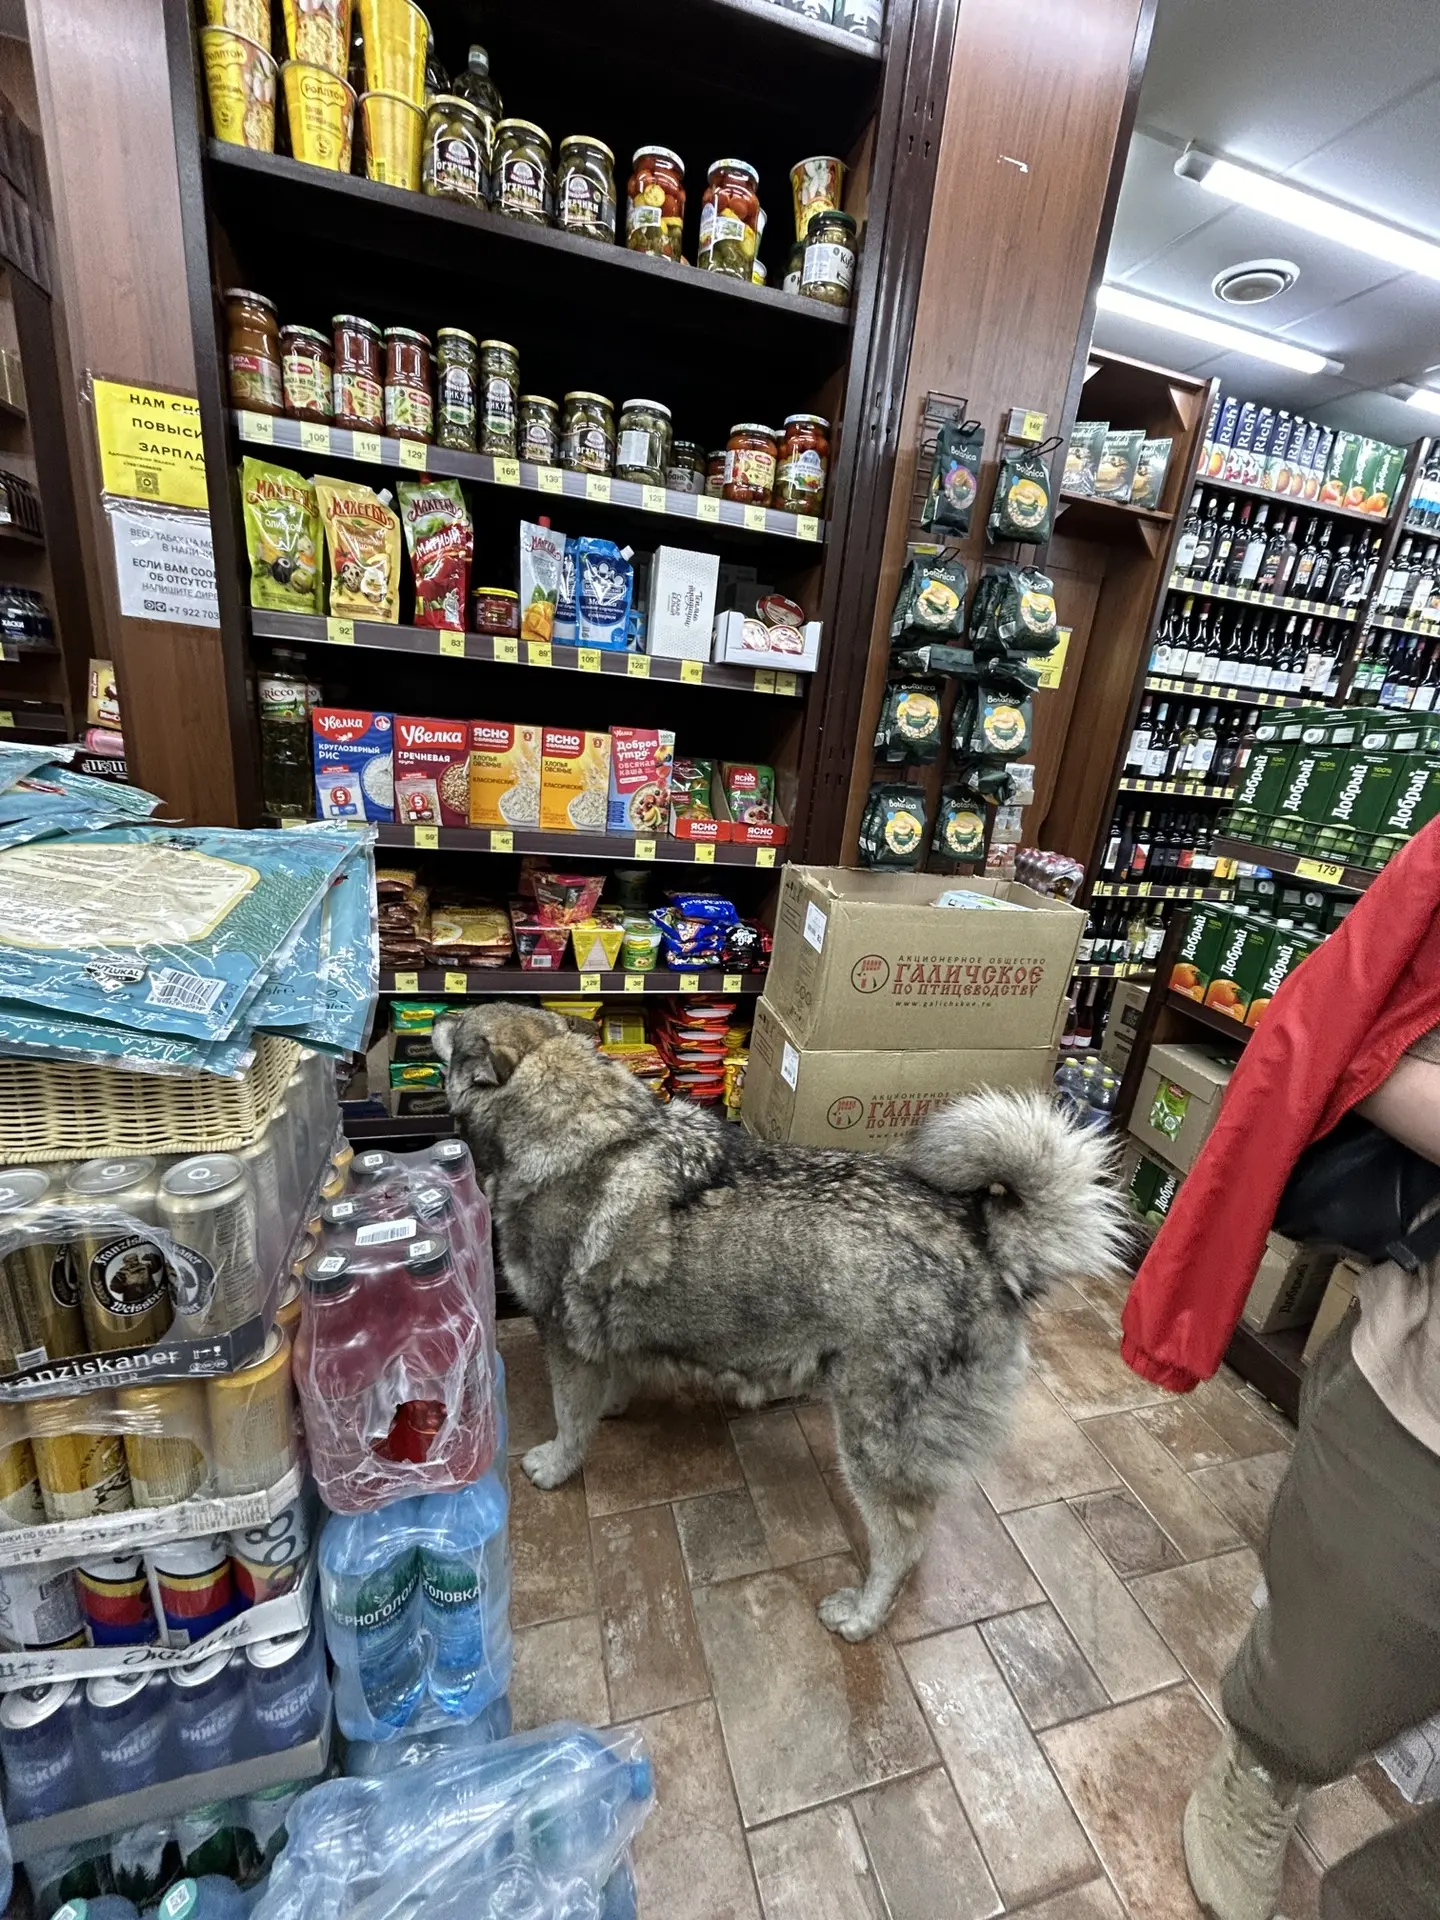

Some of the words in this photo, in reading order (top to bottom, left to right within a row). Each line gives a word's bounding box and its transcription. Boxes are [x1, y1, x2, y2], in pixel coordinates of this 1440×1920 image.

[129, 393, 165, 409] НАМ
[1220, 407, 1238, 443] Rich
[1237, 411, 1256, 447] Rich
[1254, 416, 1273, 452] Rich
[1272, 420, 1291, 456] Rich
[1288, 426, 1304, 460] Rich
[1302, 431, 1320, 465] Rich
[950, 445, 977, 461] Botanica
[1314, 434, 1332, 468] Rich
[132, 557, 162, 570] ЕСЛИ
[164, 562, 188, 575] ВАМ
[149, 571, 164, 581] ОБ
[923, 567, 956, 582] Botanica
[142, 582, 193, 597] НАПИШИТЕ
[183, 607, 200, 617] 922
[318, 715, 363, 731] Увелка
[400, 725, 462, 746] Увелка
[473, 727, 509, 739] ЯСНО
[545, 734, 580, 745] ЯСНО
[318, 743, 380, 754] КРУГЛОЗЕРНЫЙ
[616, 740, 658, 751] Доброе
[318, 752, 340, 760] РИС
[398, 751, 450, 763] ГРЕЧНЕВАЯ
[617, 749, 650, 761] утро
[1239, 754, 1269, 804] Добрый
[1282, 758, 1316, 811] Добрый
[336, 791, 345, 801] 5
[1331, 762, 1369, 820] Добрый
[414, 796, 423, 807] 5
[1388, 769, 1430, 829] Добрый
[690, 823, 718, 832] ЯСНО
[747, 827, 774, 836] ЯСНО
[1317, 863, 1337, 876] 179
[1181, 914, 1207, 961] Добрый
[898, 955, 983, 964] АКЦИОНЕРНОЕ
[989, 957, 1046, 965] ОБЩЕСТВО
[1220, 928, 1248, 977] Добрый
[893, 963, 1044, 984] ГАЛИЧСКОЕ
[1262, 943, 1294, 995] Добрый
[891, 983, 912, 995] ПО
[917, 983, 1039, 998] ПТИЦЕВОДСТВУ
[872, 1092, 950, 1101] АКЦИОНЕРНОЕ
[866, 1119, 885, 1130] ПО
